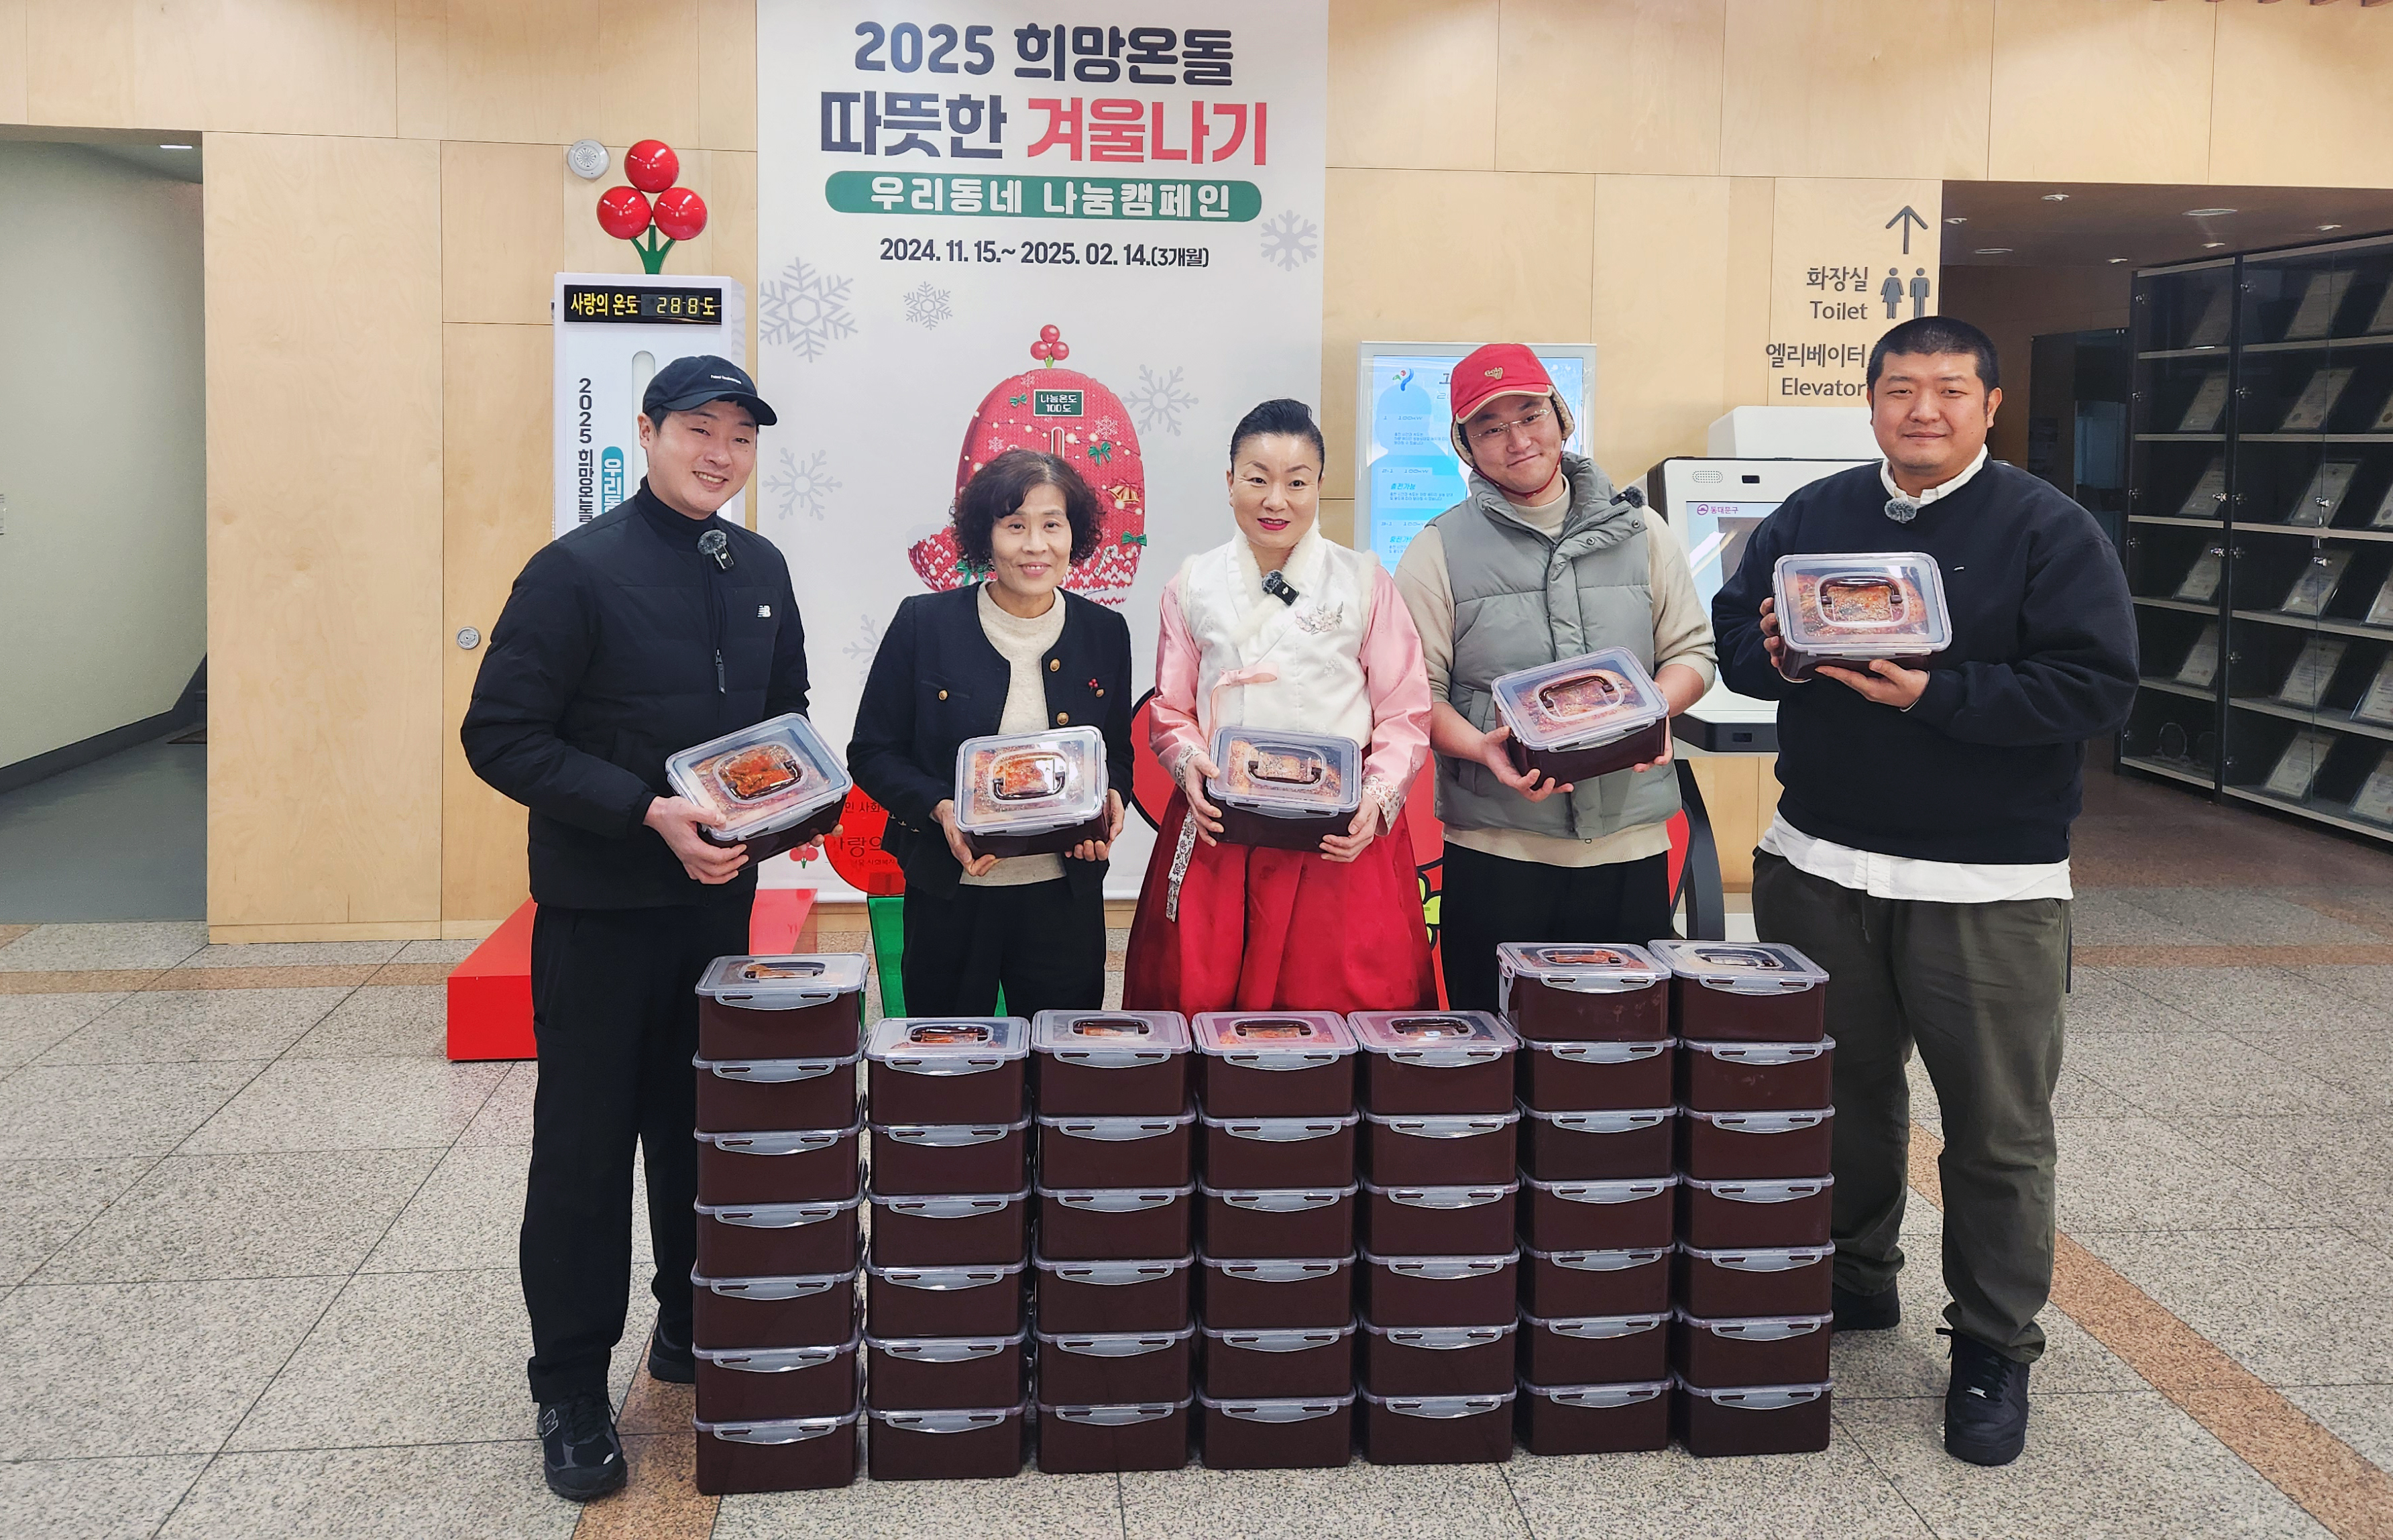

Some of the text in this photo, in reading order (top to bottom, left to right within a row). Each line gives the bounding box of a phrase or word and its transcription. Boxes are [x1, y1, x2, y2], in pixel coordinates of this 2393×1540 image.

[854, 21, 1234, 86] 2025 희망온돌
[820, 90, 1267, 166] 따뜻한 겨울나기
[871, 178, 1229, 218] 우리동네 나눔캠페인
[880, 237, 941, 261] 2024.
[946, 239, 968, 262] 11.
[1021, 241, 1080, 264] 2025.
[1086, 243, 1118, 266] 02.
[1806, 266, 1869, 292] 화장실
[570, 292, 608, 317] 사랑의
[612, 293, 638, 316] 온도
[1810, 300, 1868, 320] Toilet
[1765, 343, 1866, 368] 엘리베이터
[1781, 377, 1867, 396] Elevator
[1046, 404, 1072, 412] 100도
[578, 378, 594, 523] 2025 희망온돌
[1711, 506, 1738, 514] 동대문구
